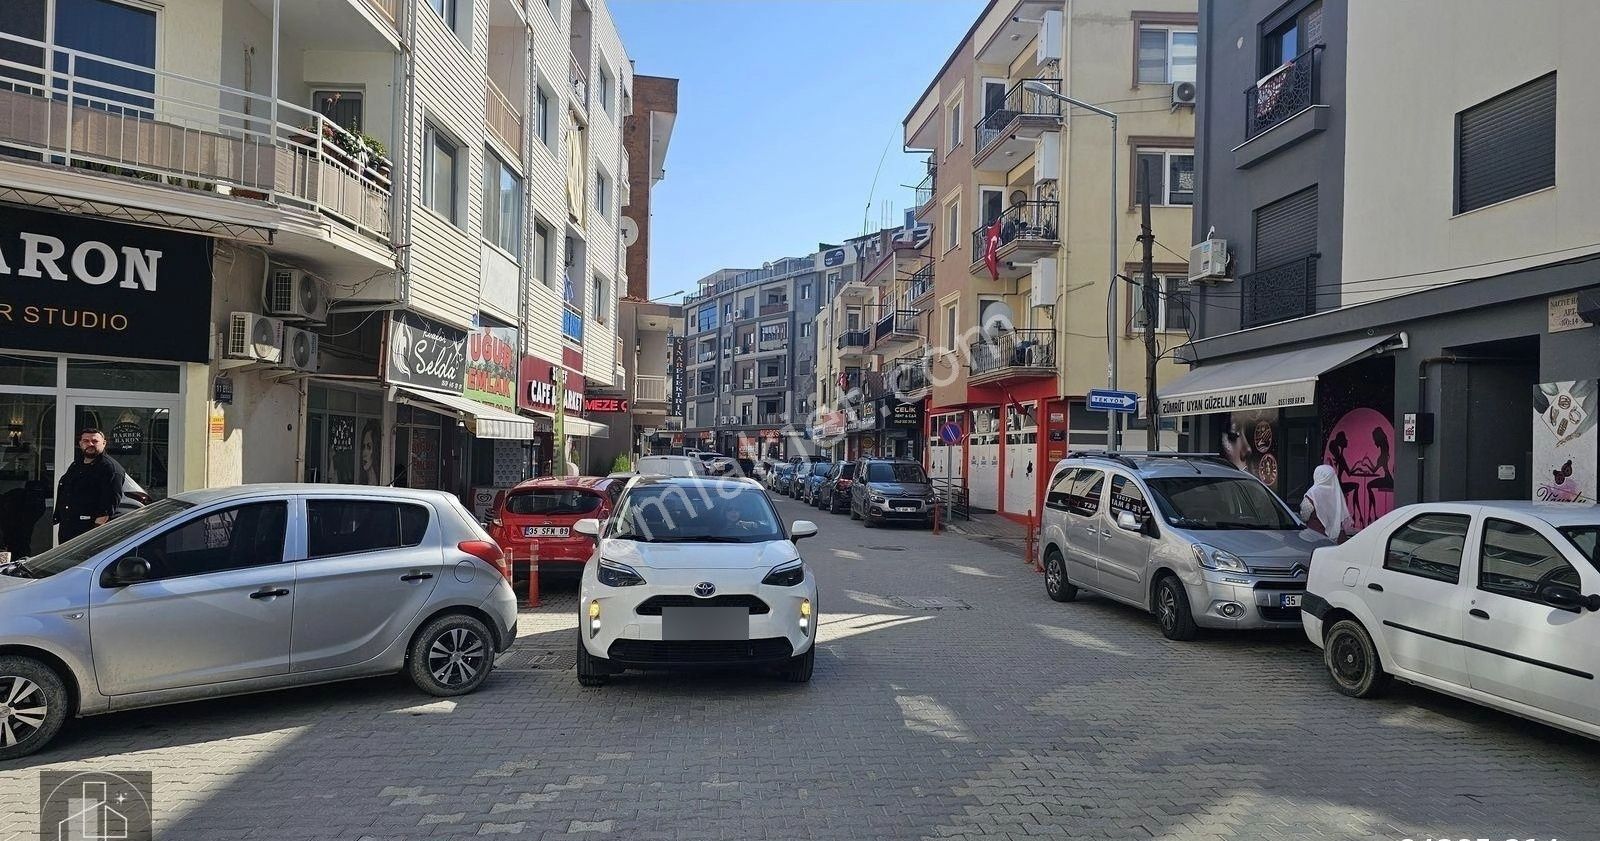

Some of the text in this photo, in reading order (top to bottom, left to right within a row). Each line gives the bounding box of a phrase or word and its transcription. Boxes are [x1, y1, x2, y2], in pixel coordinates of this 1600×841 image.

[23, 306, 128, 331] STUDIO
[414, 339, 457, 380] Selda
[470, 326, 513, 372] UĞUR
[466, 366, 511, 399] EMLAK
[531, 379, 552, 406] CAFE
[564, 389, 583, 412] ARKET
[585, 399, 619, 411] MEZE
[1186, 399, 1203, 412] UYAN
[1238, 392, 1268, 407] SALONU
[529, 527, 538, 535] 35
[1286, 596, 1296, 606] 35
